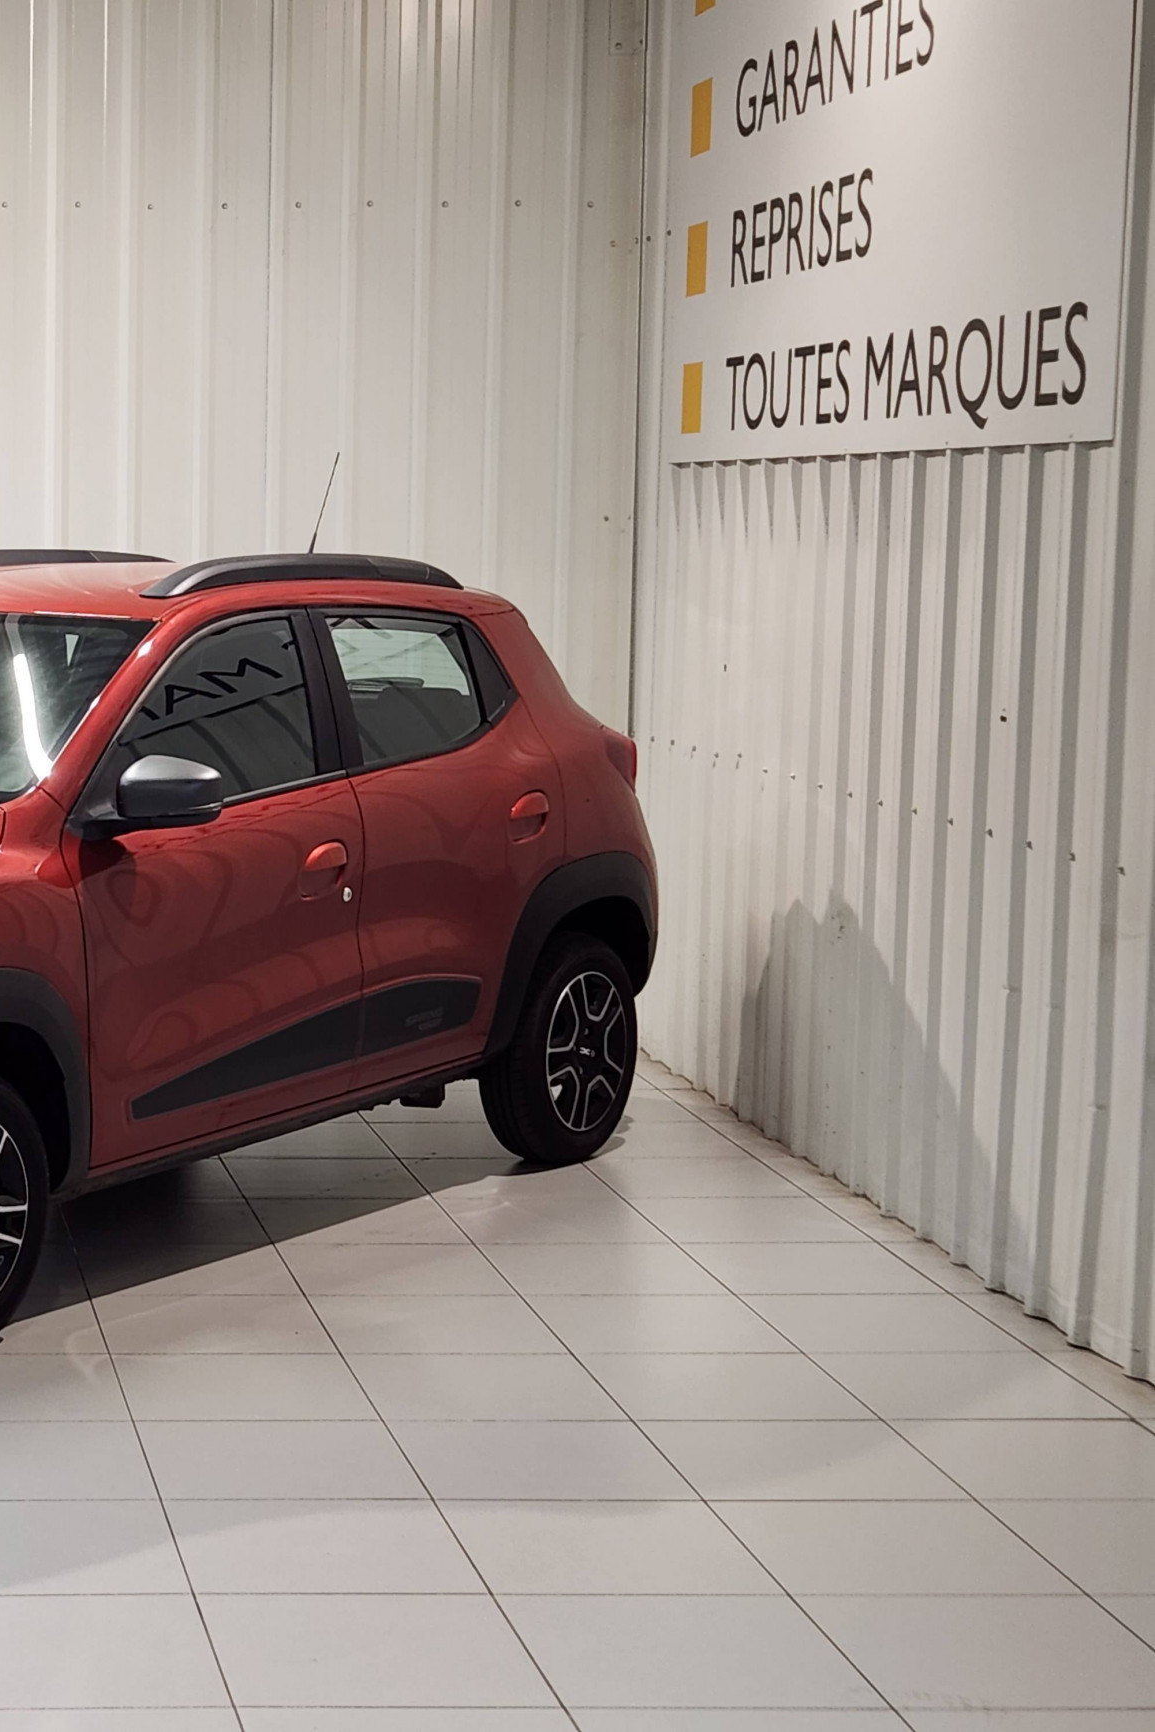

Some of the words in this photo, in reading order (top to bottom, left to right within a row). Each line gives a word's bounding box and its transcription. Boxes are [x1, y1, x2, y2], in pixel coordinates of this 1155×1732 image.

[735, 0, 935, 137] GARANTIES
[731, 168, 874, 288] REPRISES
[726, 339, 851, 431] TOUTES
[863, 301, 1088, 430] MARQUES
